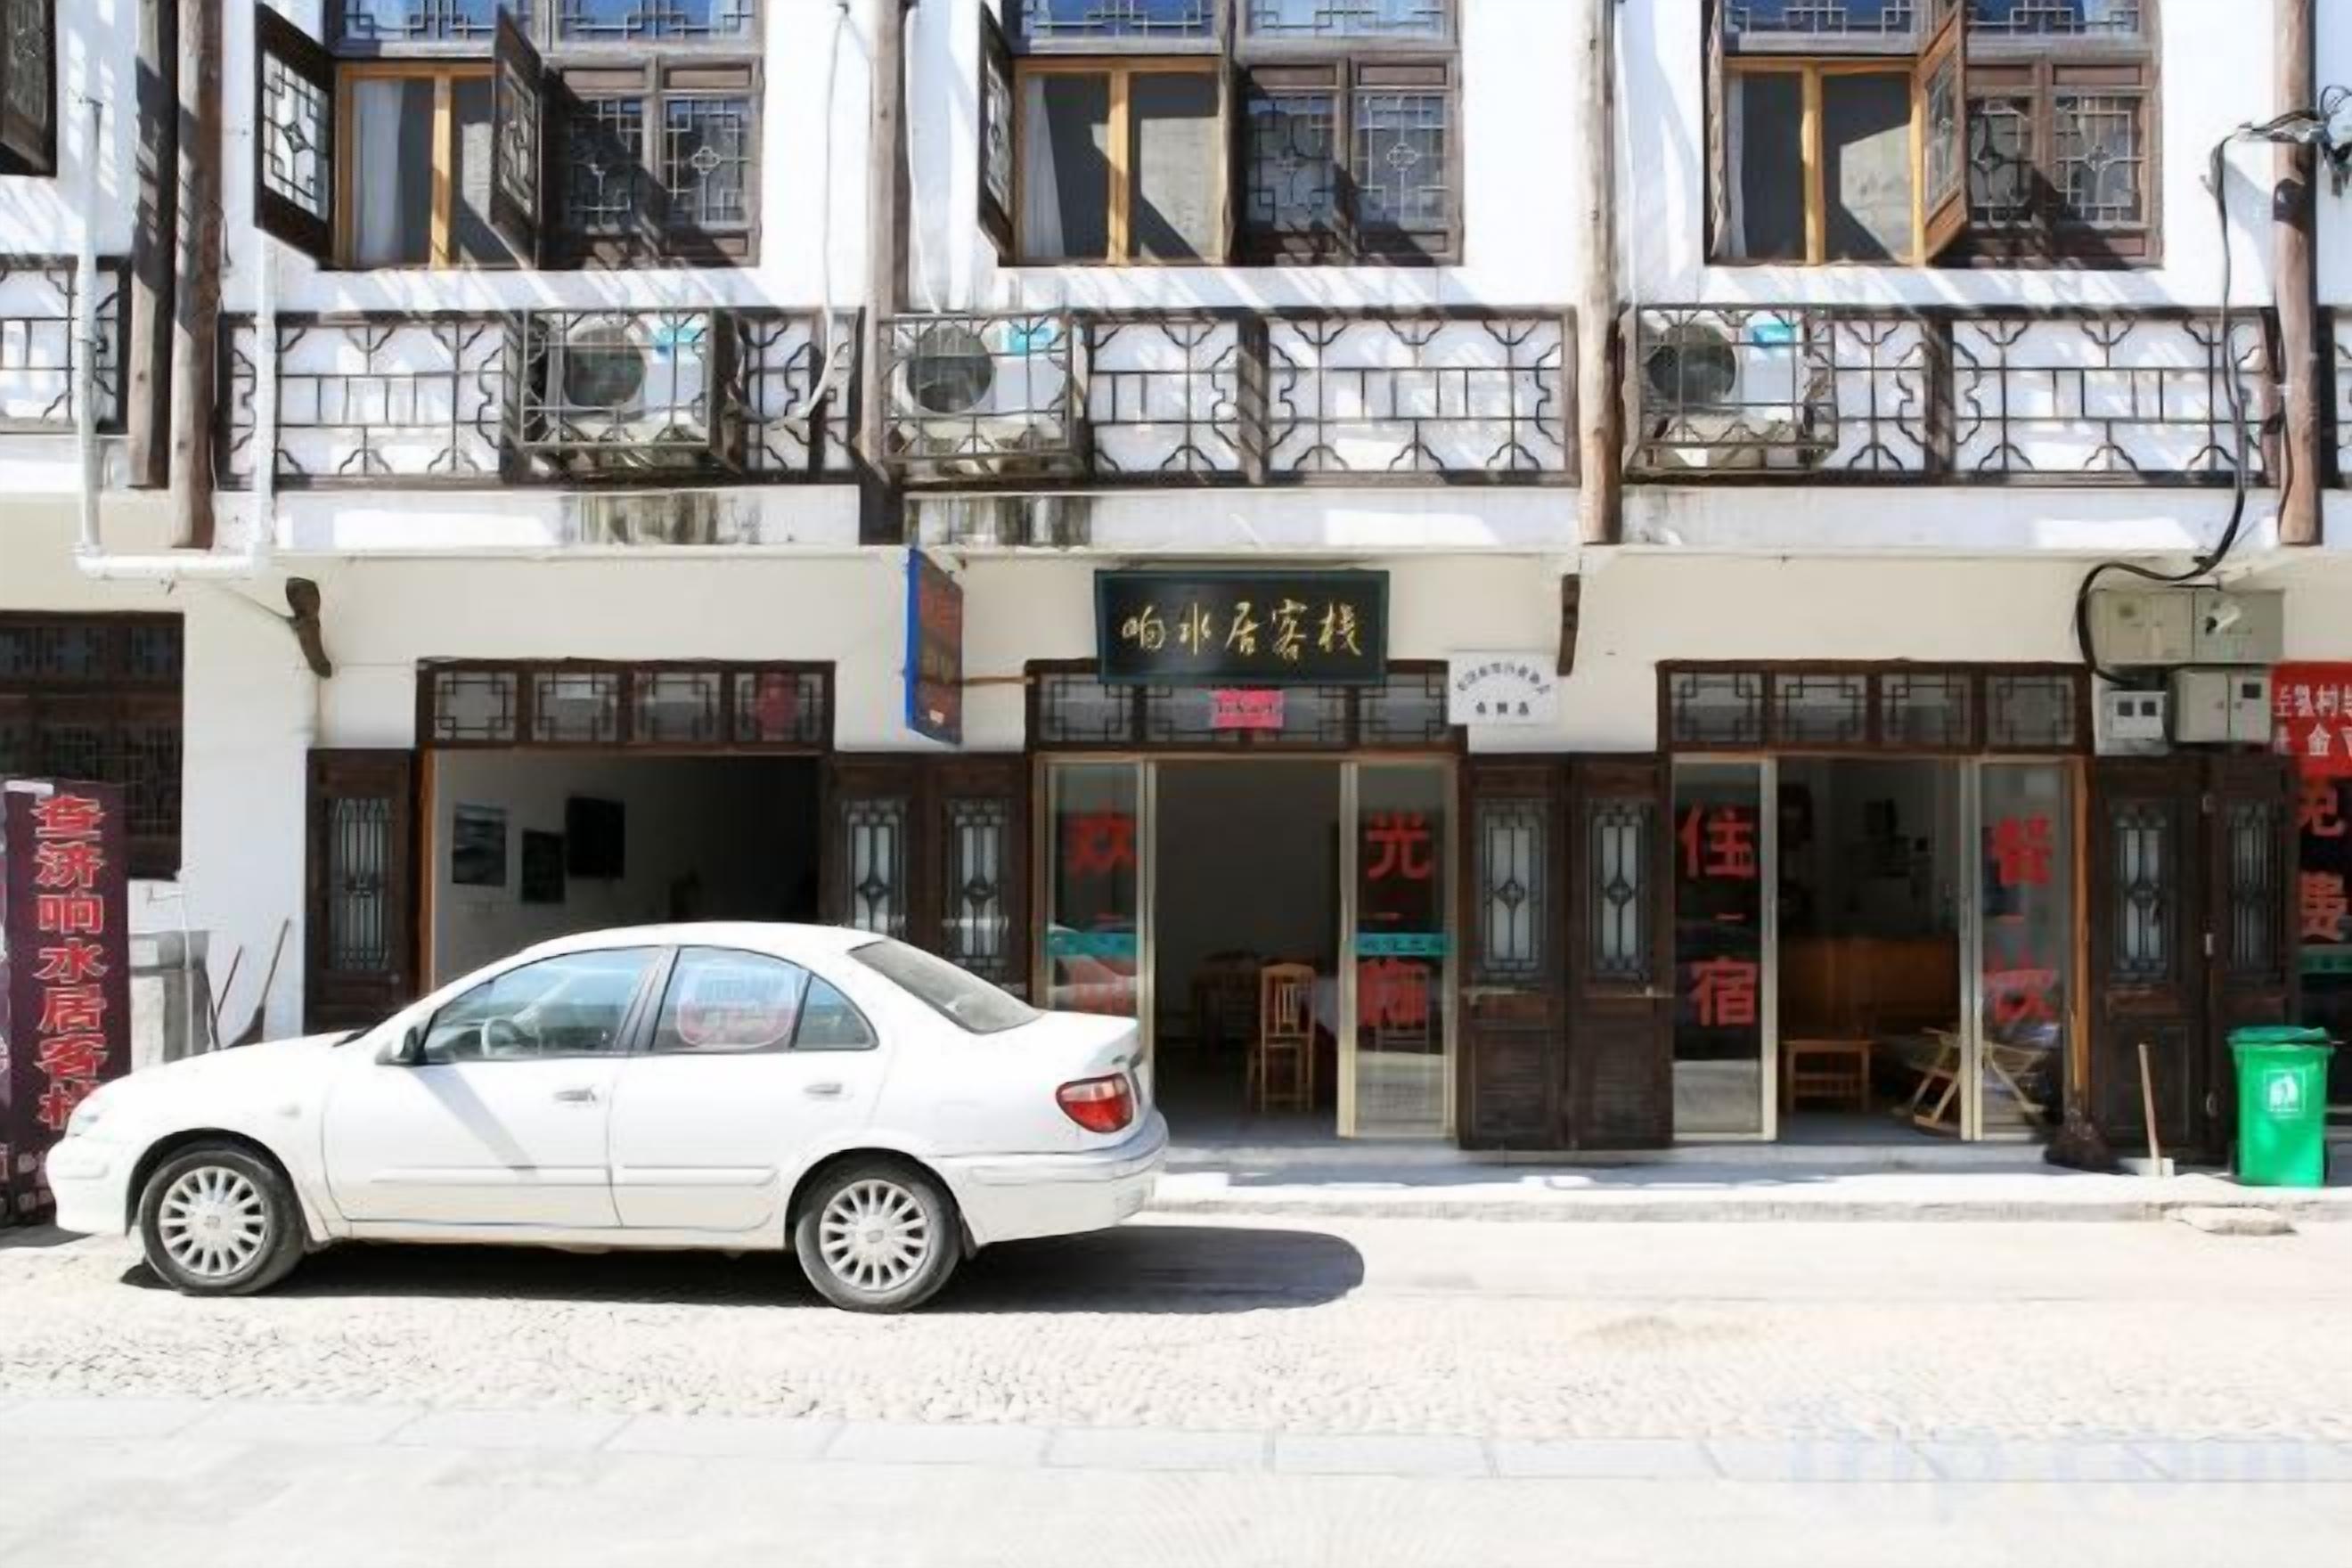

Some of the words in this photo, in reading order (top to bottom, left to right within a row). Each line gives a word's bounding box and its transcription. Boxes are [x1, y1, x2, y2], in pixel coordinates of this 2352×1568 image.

[1122, 599, 1361, 660] 响水居客栈
